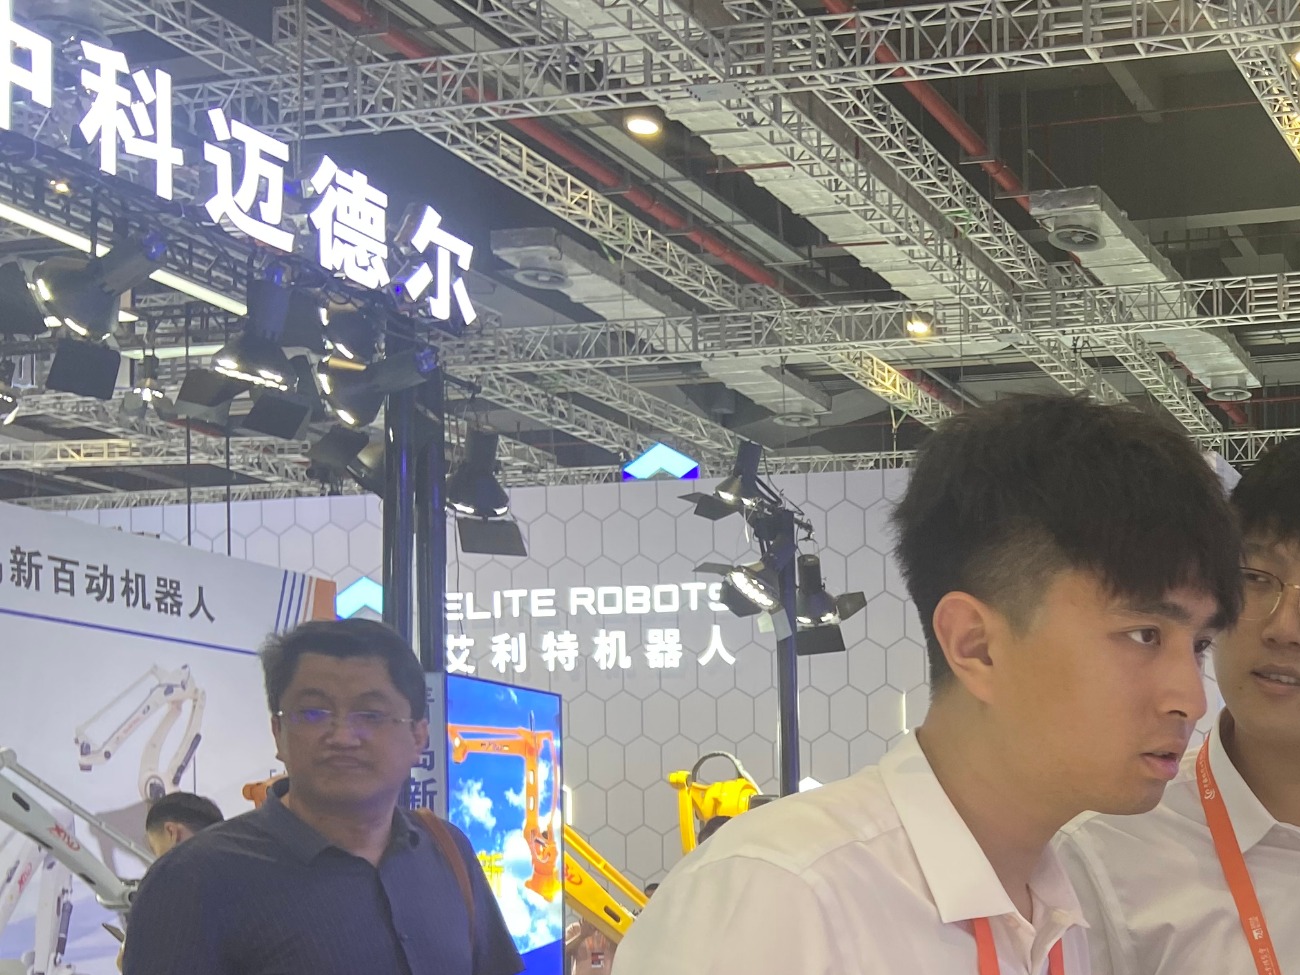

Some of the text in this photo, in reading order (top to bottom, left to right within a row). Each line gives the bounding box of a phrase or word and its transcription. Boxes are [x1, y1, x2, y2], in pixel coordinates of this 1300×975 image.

[0, 0, 478, 327] 中科迈德尔
[0, 545, 216, 624] 新百动机器人
[445, 588, 557, 621] ELITE
[446, 625, 736, 674] 艾利特机器人
